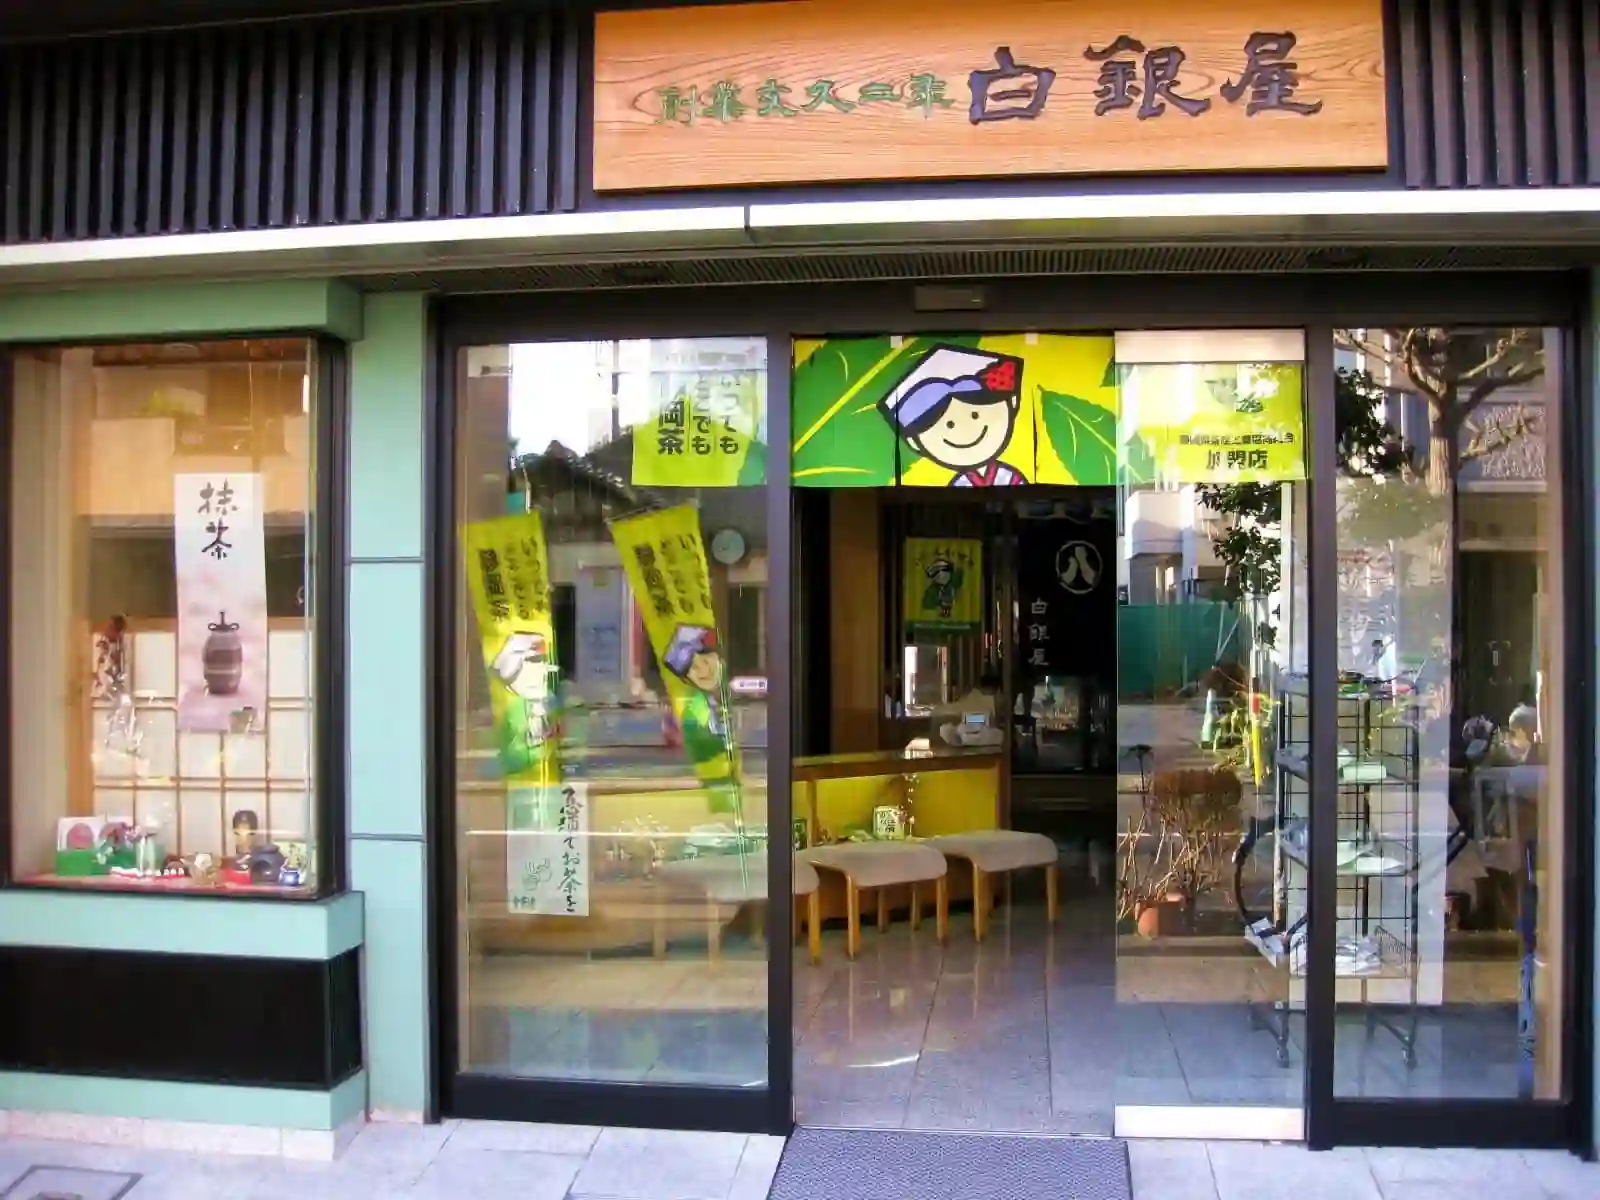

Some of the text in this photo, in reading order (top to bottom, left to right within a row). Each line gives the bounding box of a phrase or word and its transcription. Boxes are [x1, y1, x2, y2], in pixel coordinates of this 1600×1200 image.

[968, 32, 1323, 125] 白銀屋
[198, 479, 239, 560] 抹茶
[1028, 596, 1050, 666] 白銀屋
